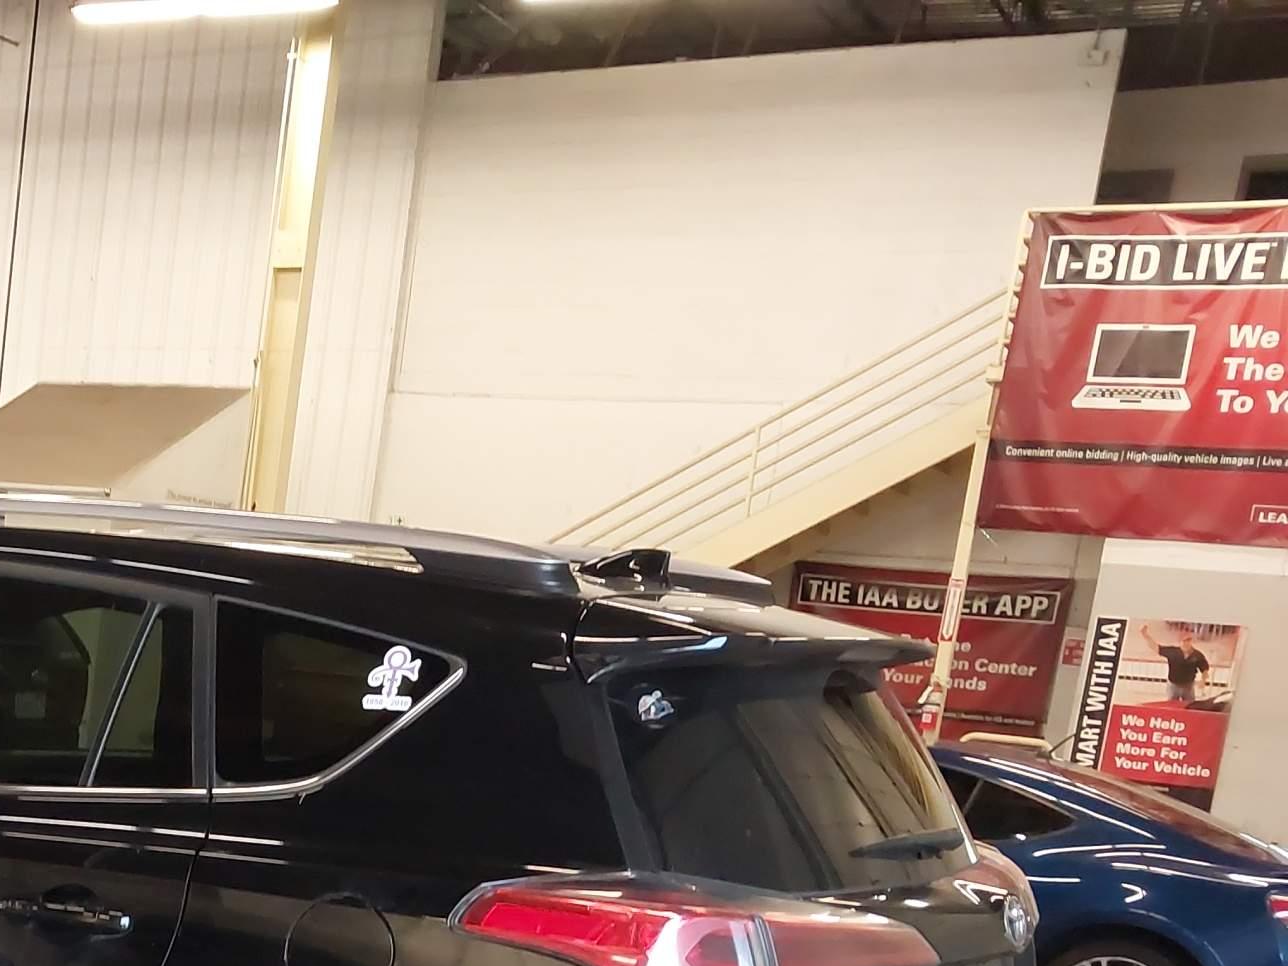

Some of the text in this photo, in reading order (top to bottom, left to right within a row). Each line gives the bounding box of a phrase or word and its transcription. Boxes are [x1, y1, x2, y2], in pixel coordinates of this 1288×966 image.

[1055, 243, 1161, 282] I-BID
[1172, 242, 1269, 281] LIVE
[1229, 324, 1281, 349] We
[1223, 356, 1285, 381] The
[1216, 388, 1255, 414] To
[1005, 445, 1054, 458] Convenient
[1055, 447, 1084, 459] online
[1085, 447, 1119, 462] bidding
[1126, 447, 1182, 464] High-quality
[1184, 452, 1218, 464] vehicle
[1220, 453, 1254, 467] images
[1262, 455, 1283, 467] Live
[808, 579, 852, 604] THE
[857, 584, 899, 609] IAA
[994, 593, 1050, 618] APP
[1096, 622, 1122, 657] IAA
[882, 667, 925, 685] Your
[974, 659, 1038, 678] Center
[1085, 661, 1114, 712] WITH
[1121, 713, 1185, 733] We Help
[1119, 728, 1188, 746] You Earn
[1115, 742, 1187, 761] More For
[1114, 756, 1211, 778] Your Vehicle
